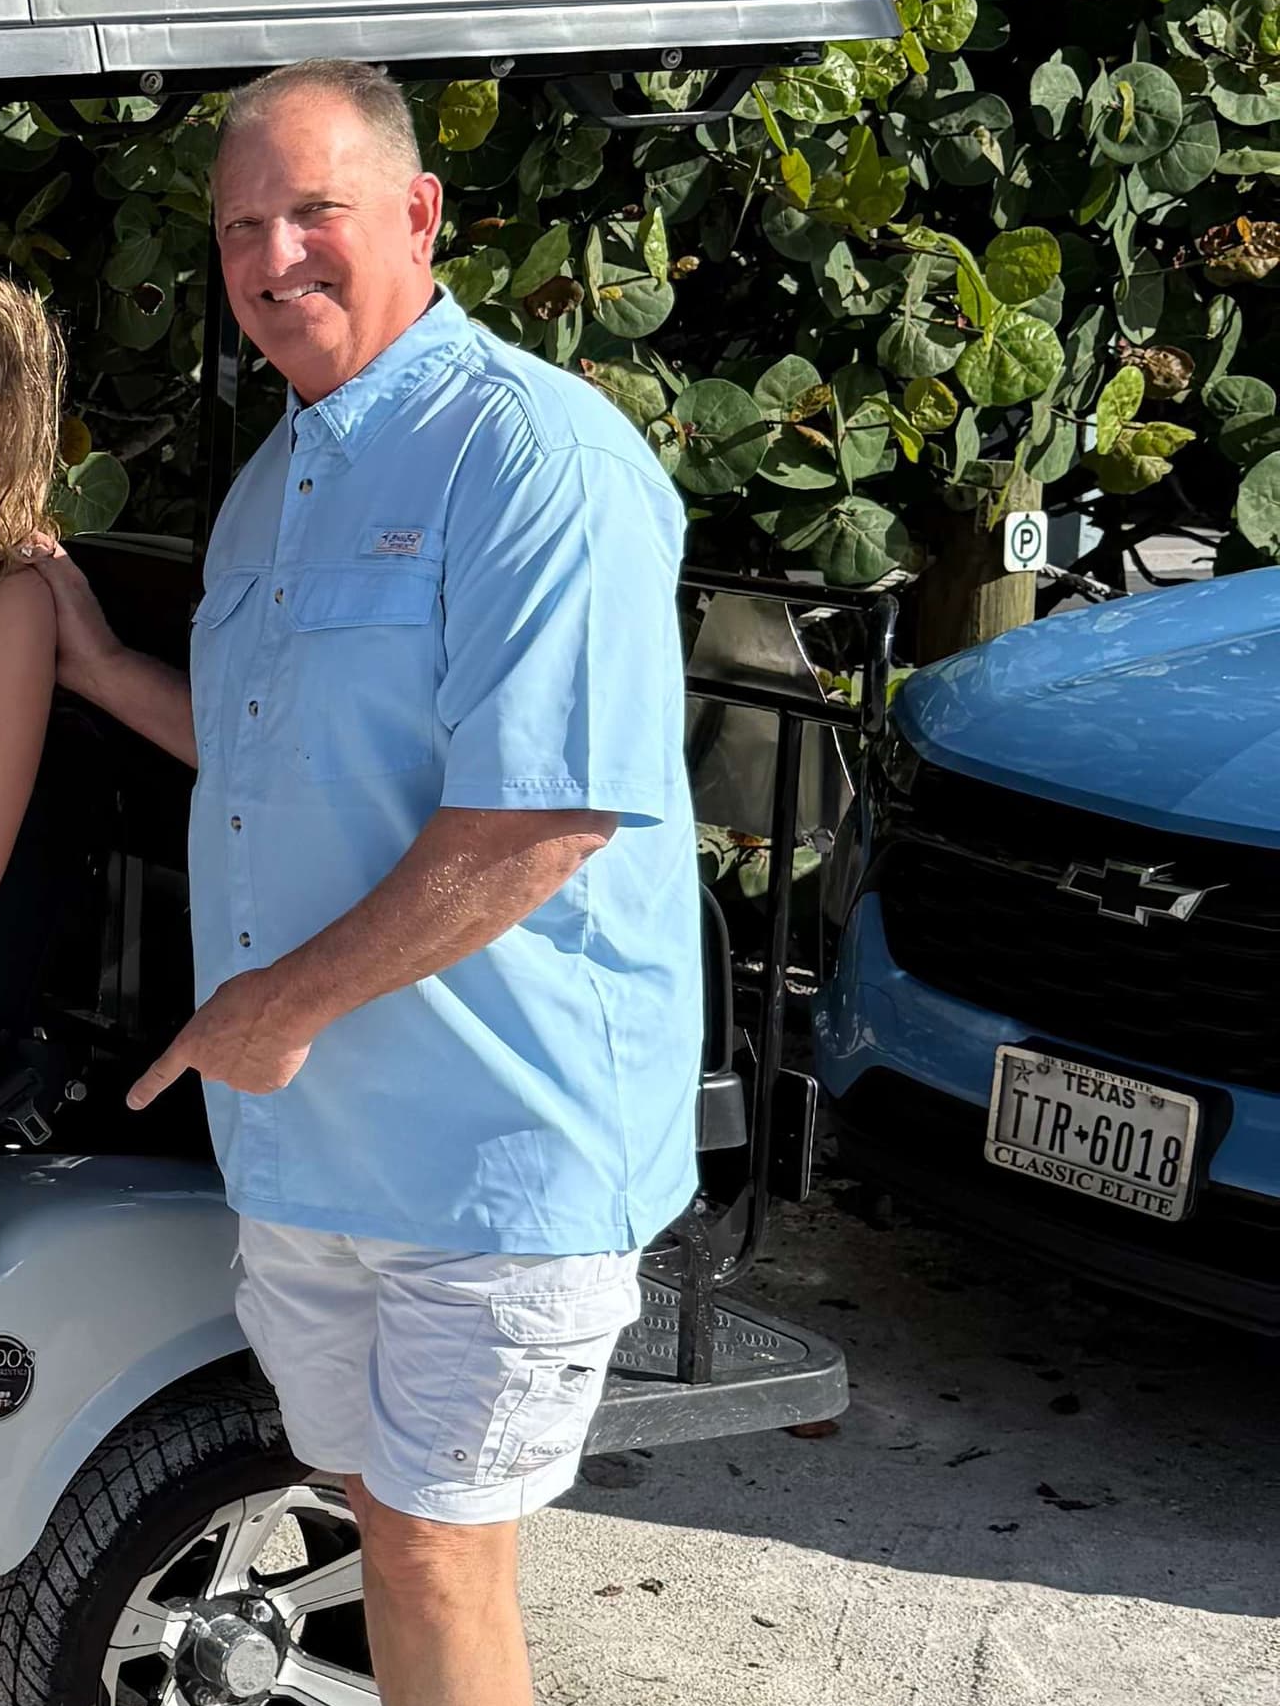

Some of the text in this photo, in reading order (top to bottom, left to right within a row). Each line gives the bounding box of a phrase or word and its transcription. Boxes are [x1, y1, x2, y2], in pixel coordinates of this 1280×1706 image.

[1020, 528, 1034, 554] P
[1062, 1070, 1136, 1109] TEXAS
[994, 1147, 1173, 1217] CLASSIC ELITE
